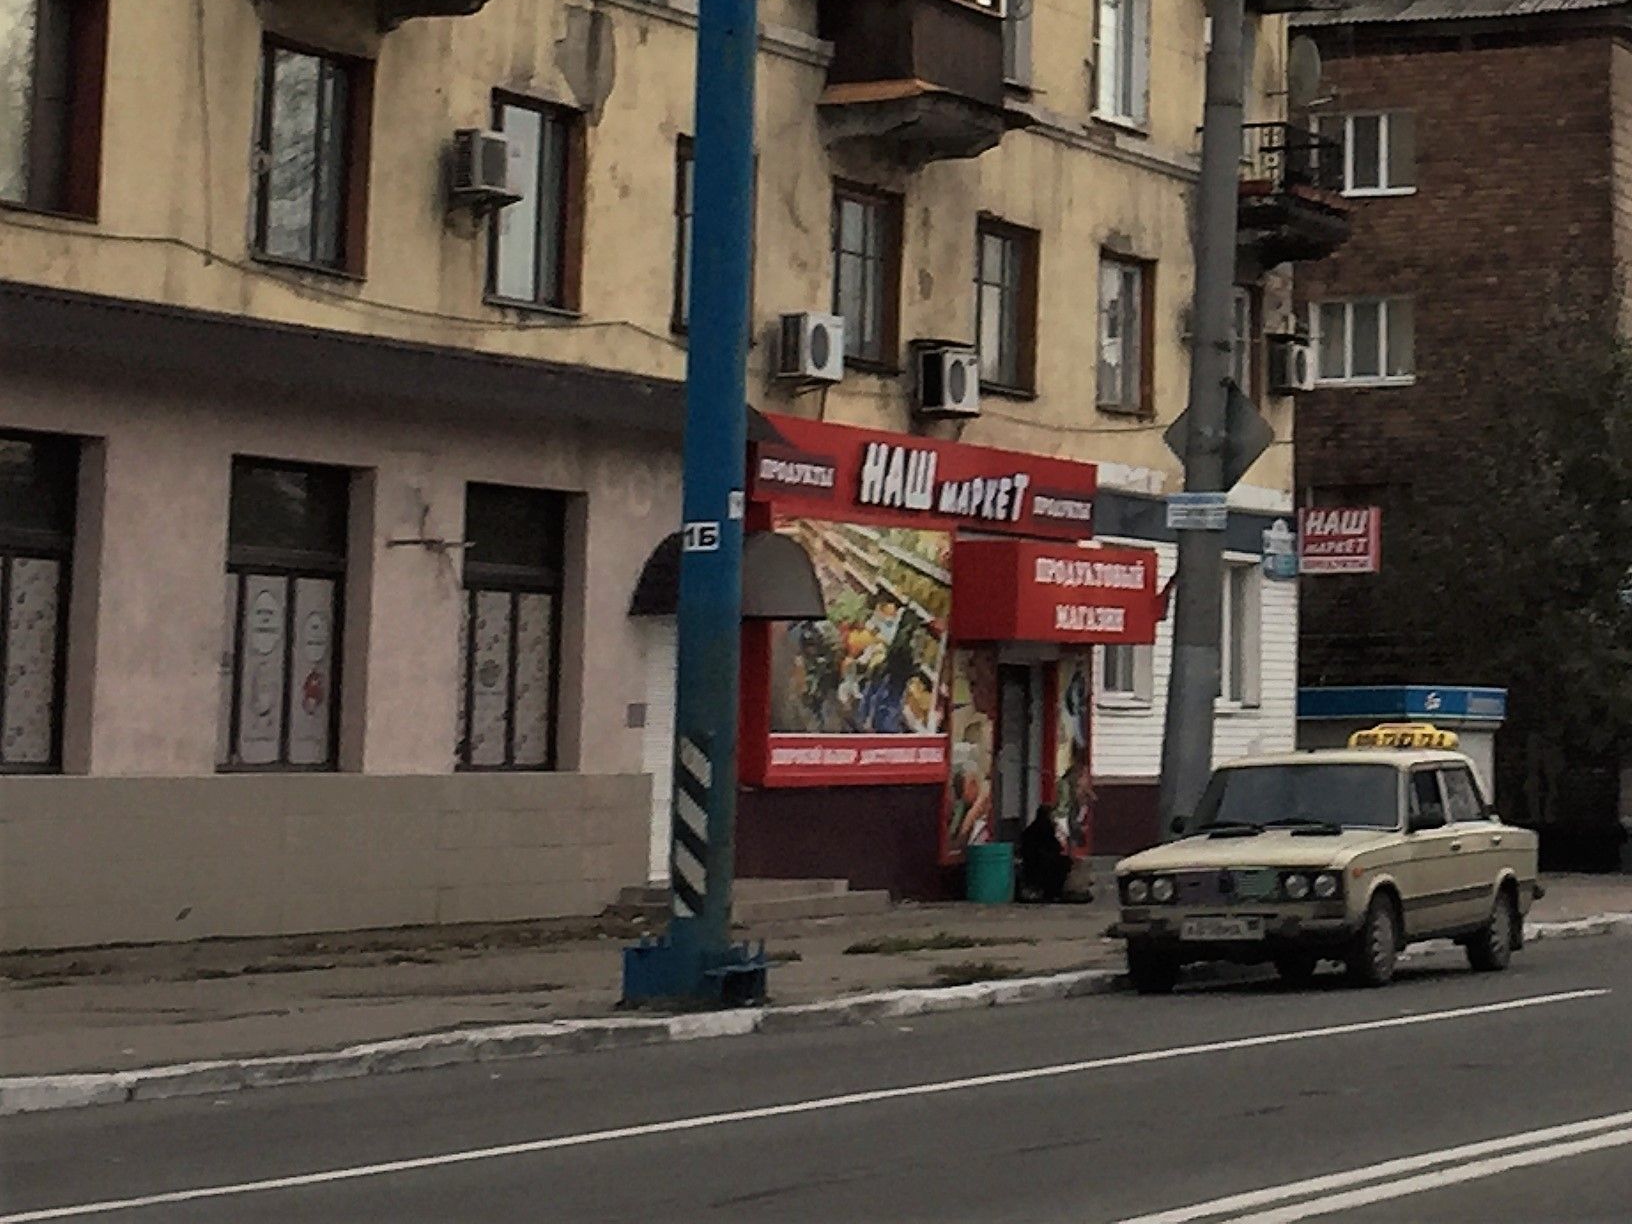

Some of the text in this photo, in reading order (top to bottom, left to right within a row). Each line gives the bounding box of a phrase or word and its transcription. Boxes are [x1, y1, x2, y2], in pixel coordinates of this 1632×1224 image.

[860, 441, 1029, 522] НАШ МАРКЕТ
[1306, 510, 1370, 537] НАШ
